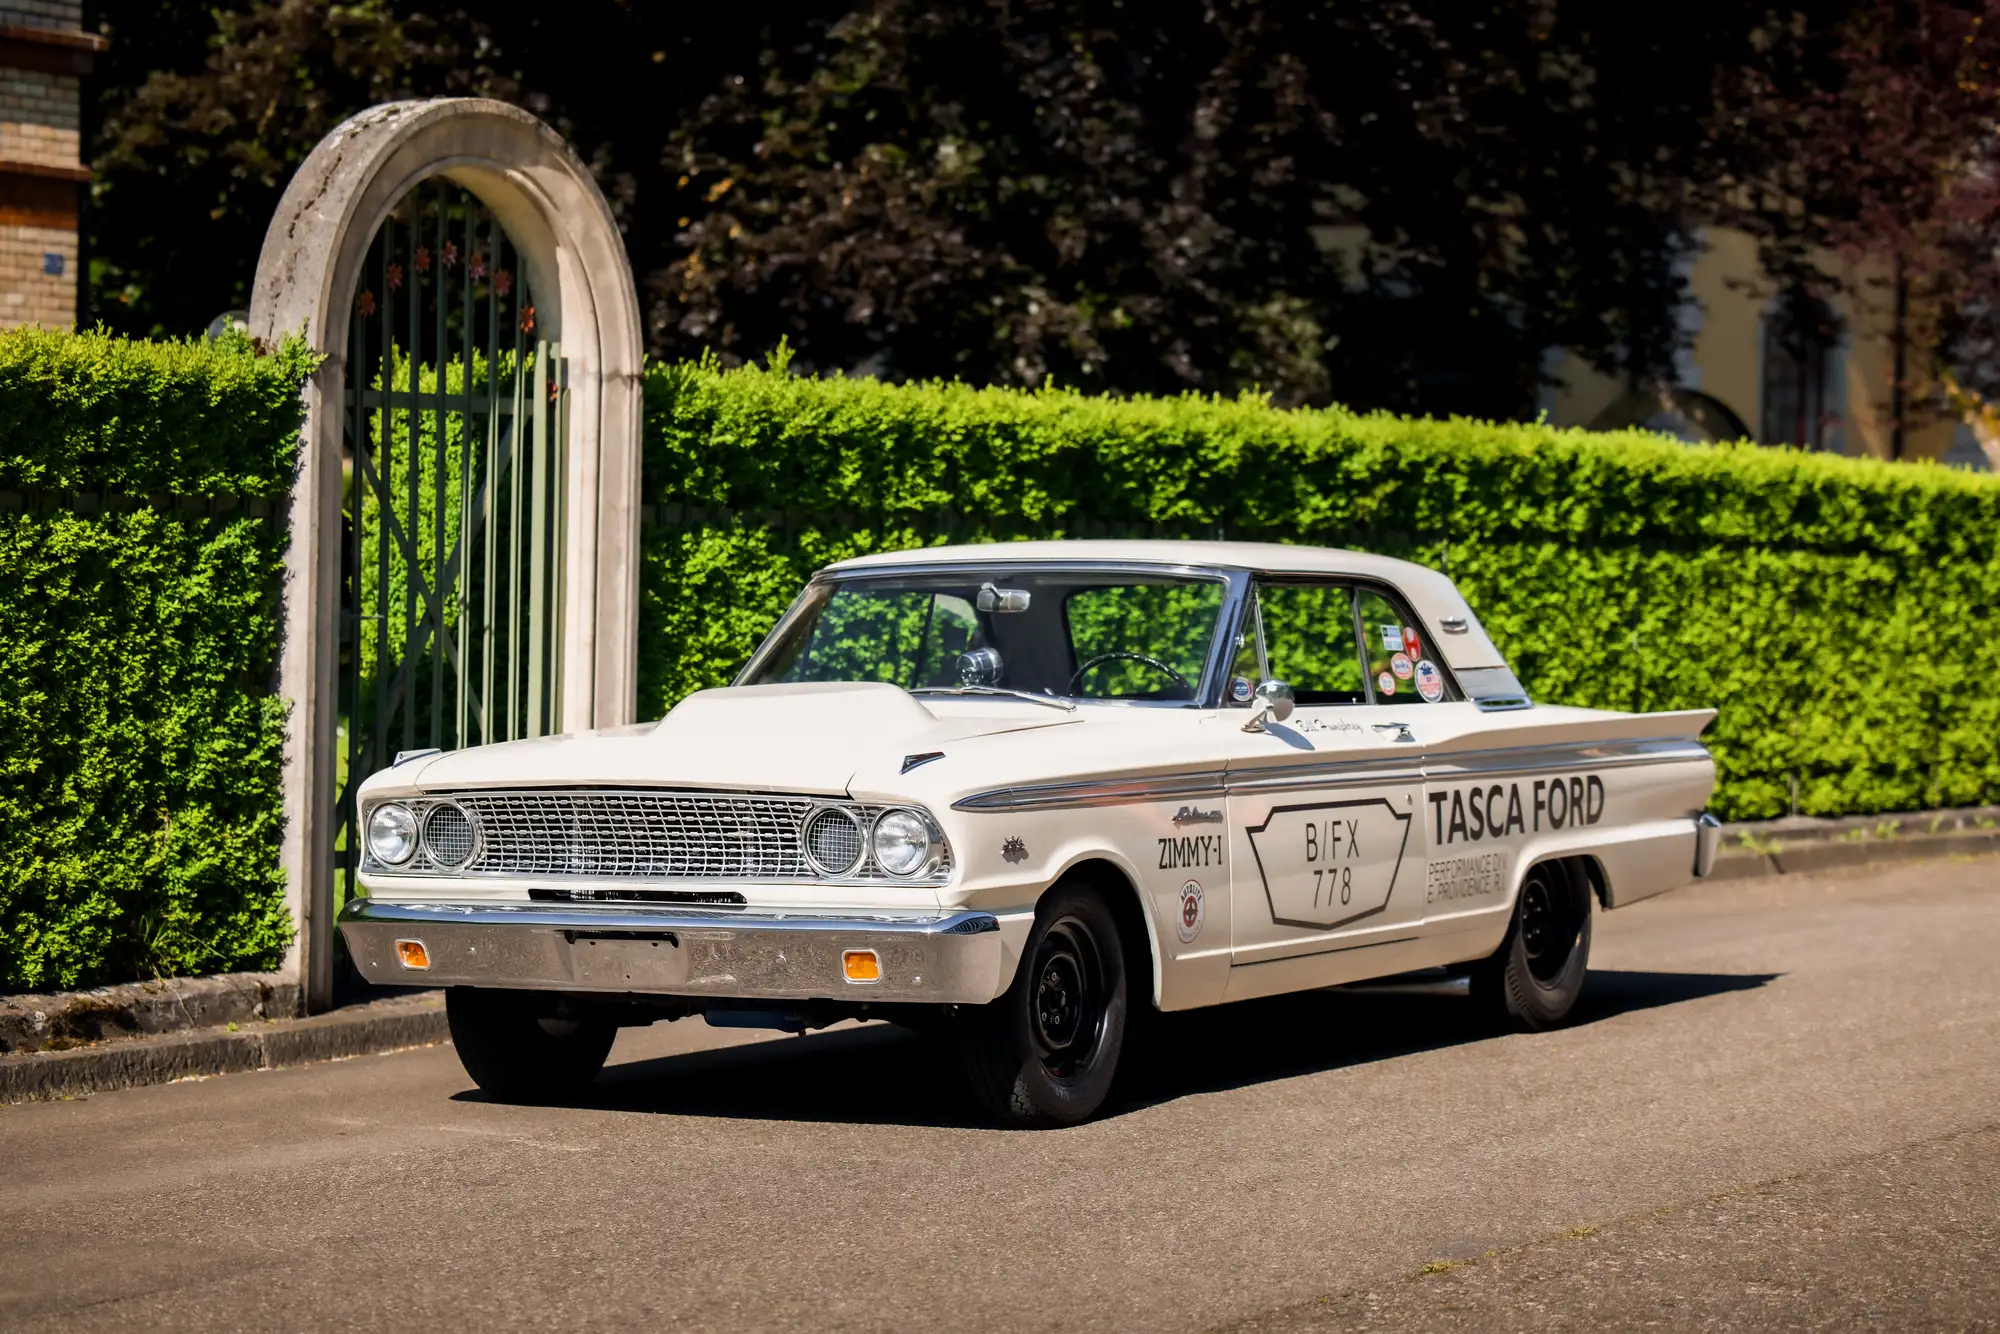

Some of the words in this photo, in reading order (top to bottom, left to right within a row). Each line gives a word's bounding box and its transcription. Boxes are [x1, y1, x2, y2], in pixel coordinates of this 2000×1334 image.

[1429, 783, 1525, 846] TASCA
[1533, 775, 1605, 832] FORD
[1306, 819, 1359, 862] B/FX
[1313, 867, 1351, 908] 778
[1428, 856, 1491, 883] PERFORMANCE
